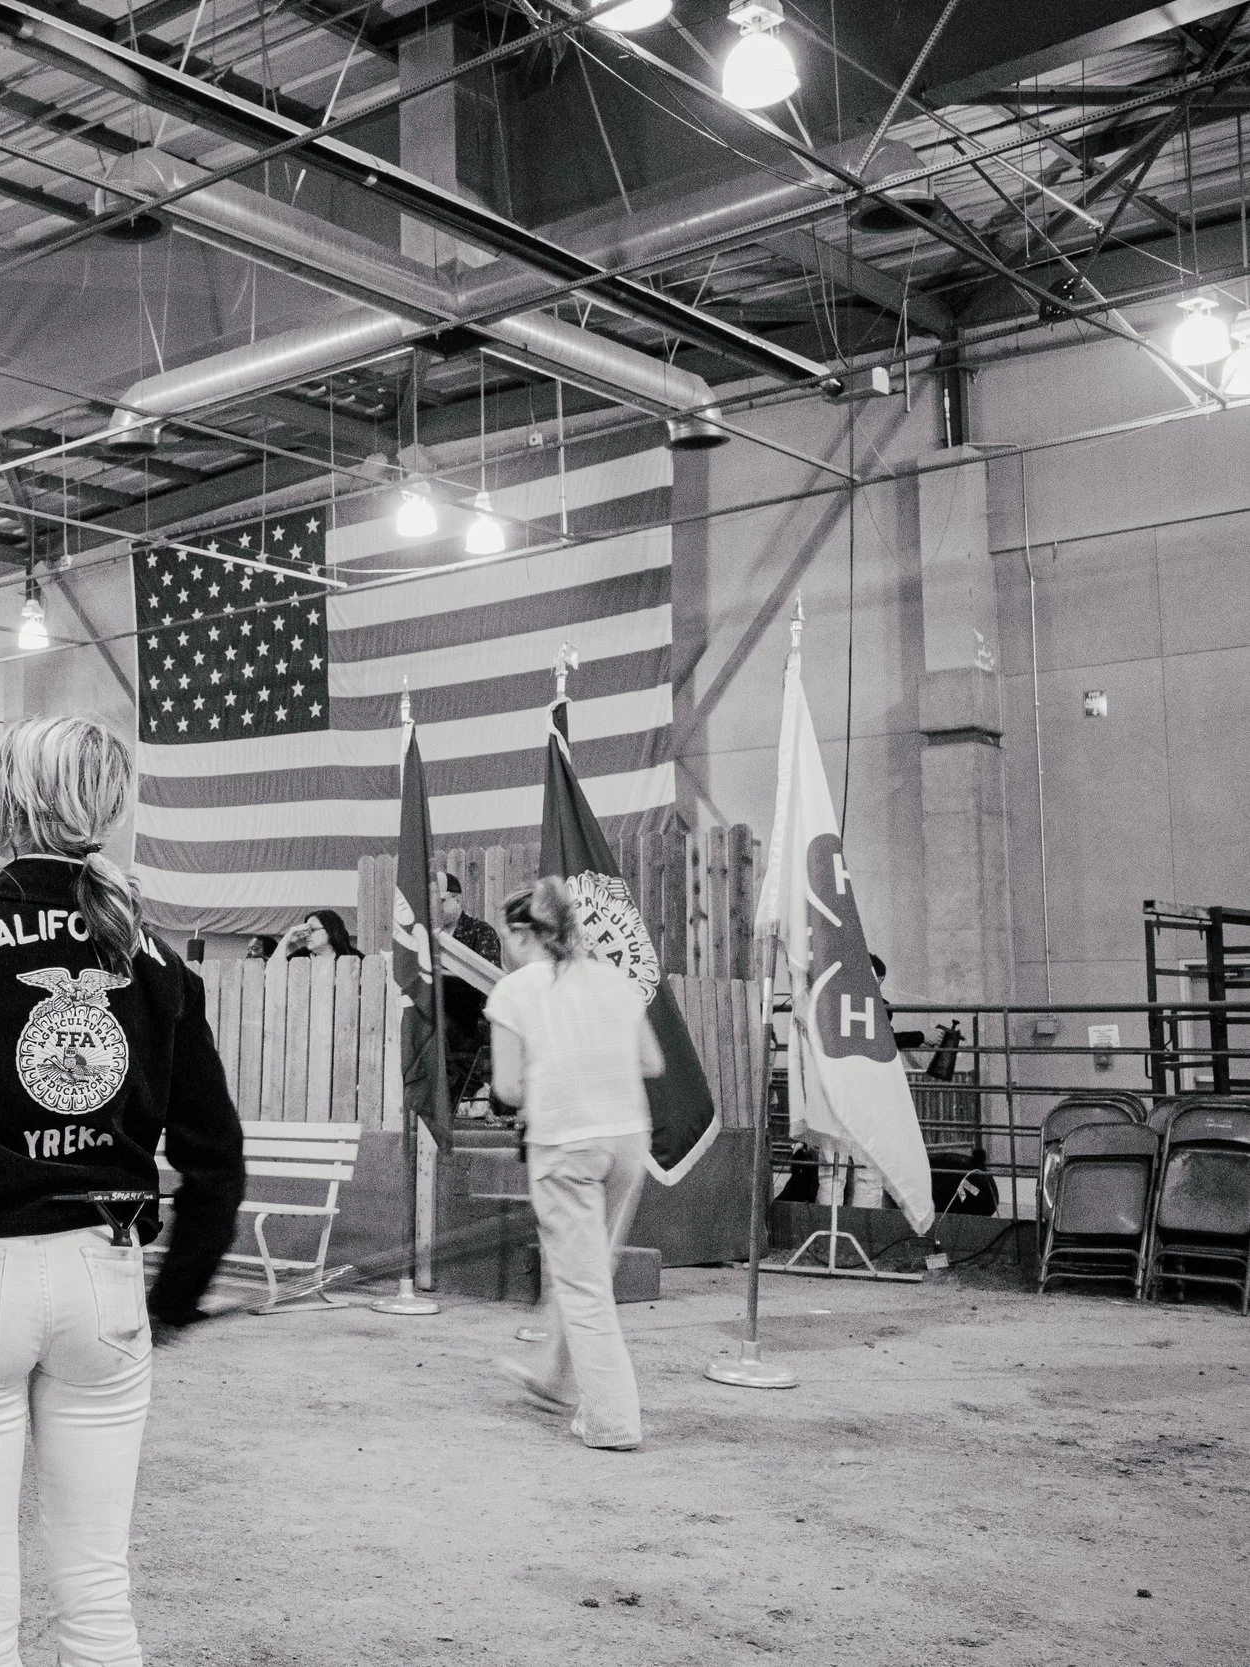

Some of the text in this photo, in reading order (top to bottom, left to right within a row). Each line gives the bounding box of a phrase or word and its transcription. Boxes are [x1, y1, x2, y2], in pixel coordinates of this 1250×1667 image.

[582, 910, 623, 967] FFA
[840, 994, 875, 1039] H
[37, 1017, 111, 1051] AGRICULTURAL
[55, 1031, 96, 1048] FFA
[41, 1075, 104, 1096] EDUCATION
